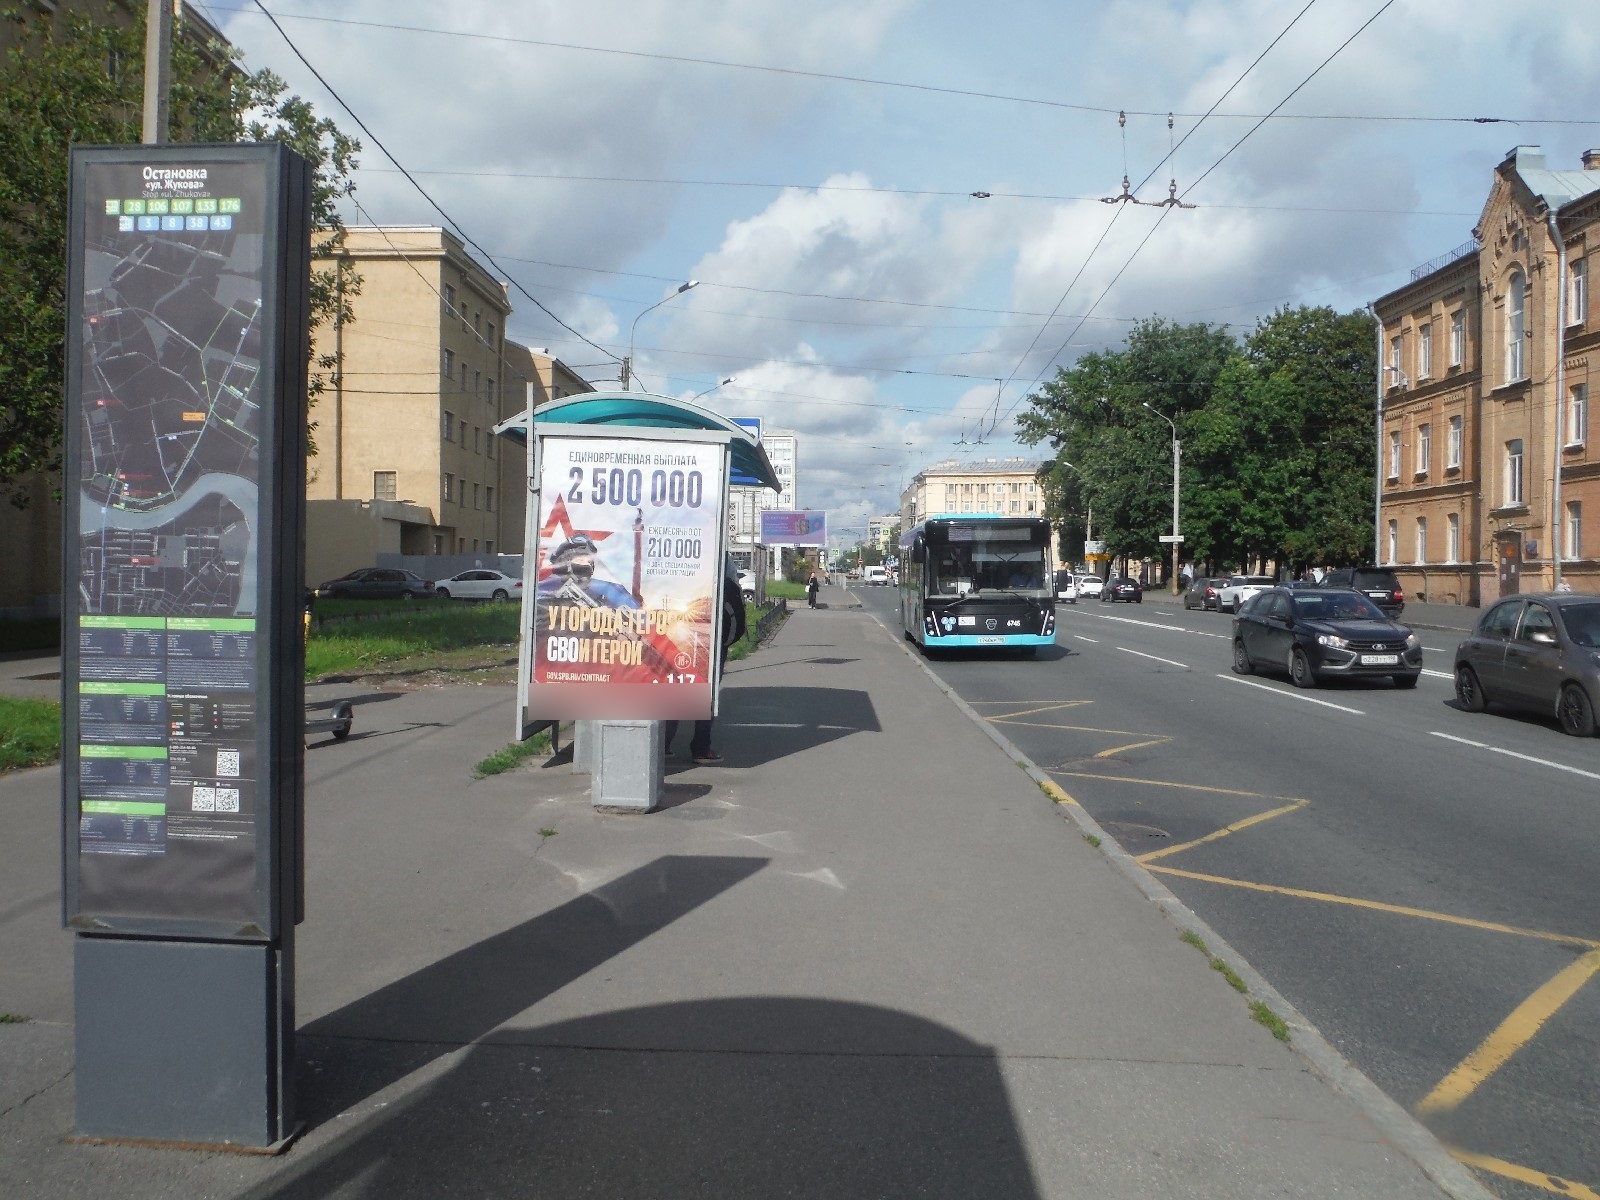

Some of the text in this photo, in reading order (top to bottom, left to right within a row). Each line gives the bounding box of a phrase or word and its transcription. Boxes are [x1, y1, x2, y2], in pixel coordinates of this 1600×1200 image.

[142, 166, 208, 180] Остановка
[145, 180, 204, 191] «ул. Жукова»
[128, 201, 141, 212] 28
[148, 201, 167, 211] 106
[173, 201, 191, 211] 107
[197, 200, 216, 211] 133
[221, 200, 239, 211] 176
[169, 217, 176, 228] 8
[190, 218, 204, 228] 38
[568, 451, 698, 466] ЕДИНОВРЕМЕННАЯ ВЫПЛАТА
[567, 466, 703, 509] 2 500 000
[648, 526, 692, 537] ЕЖЕМЕСЯЧНО
[647, 537, 702, 559] 210 000
[548, 605, 559, 631] У
[546, 635, 644, 667] СВОИ ГЕРОИ
